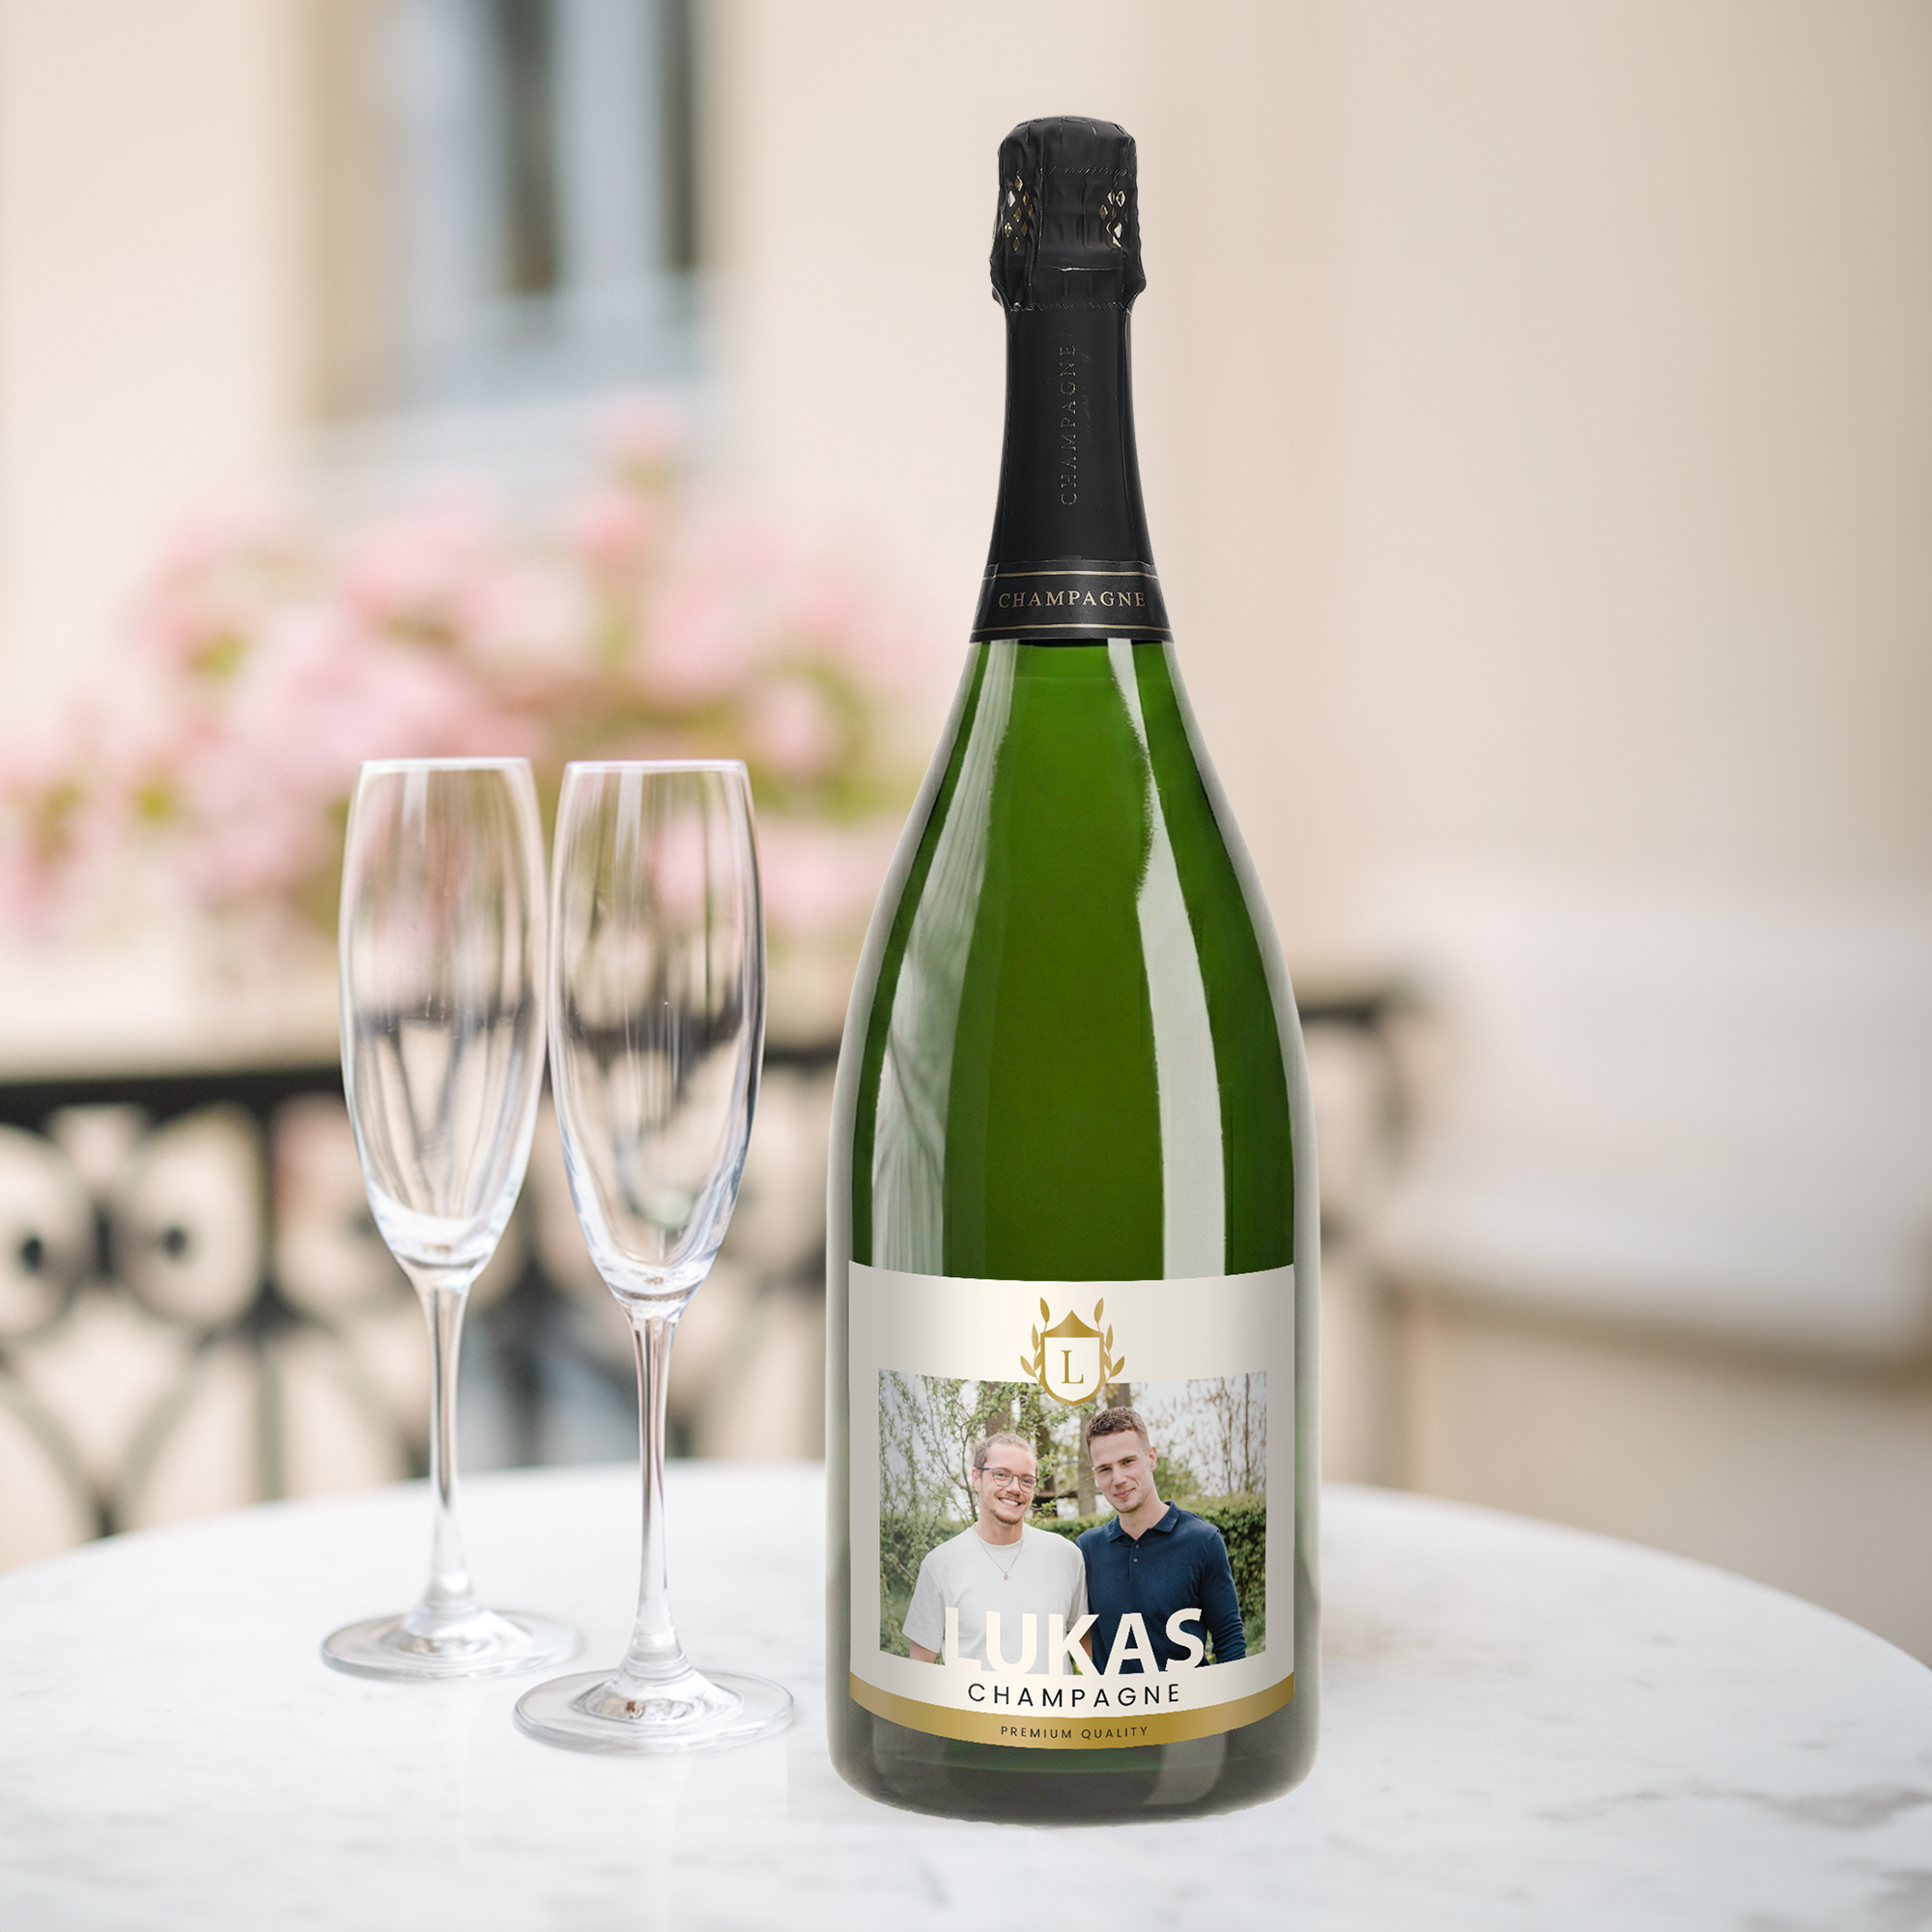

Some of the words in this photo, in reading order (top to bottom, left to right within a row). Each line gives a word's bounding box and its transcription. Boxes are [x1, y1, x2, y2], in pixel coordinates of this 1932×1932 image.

[1060, 345, 1077, 506] CHAMPAGNE
[998, 590, 1146, 609] CHAMPAGNE
[1061, 1350, 1084, 1384] L
[945, 1606, 1206, 1676] LUKAS
[968, 1683, 1179, 1708] CHAMPAGNE
[1001, 1725, 1072, 1739] PREMIUM
[1081, 1726, 1148, 1740] QUALITY
